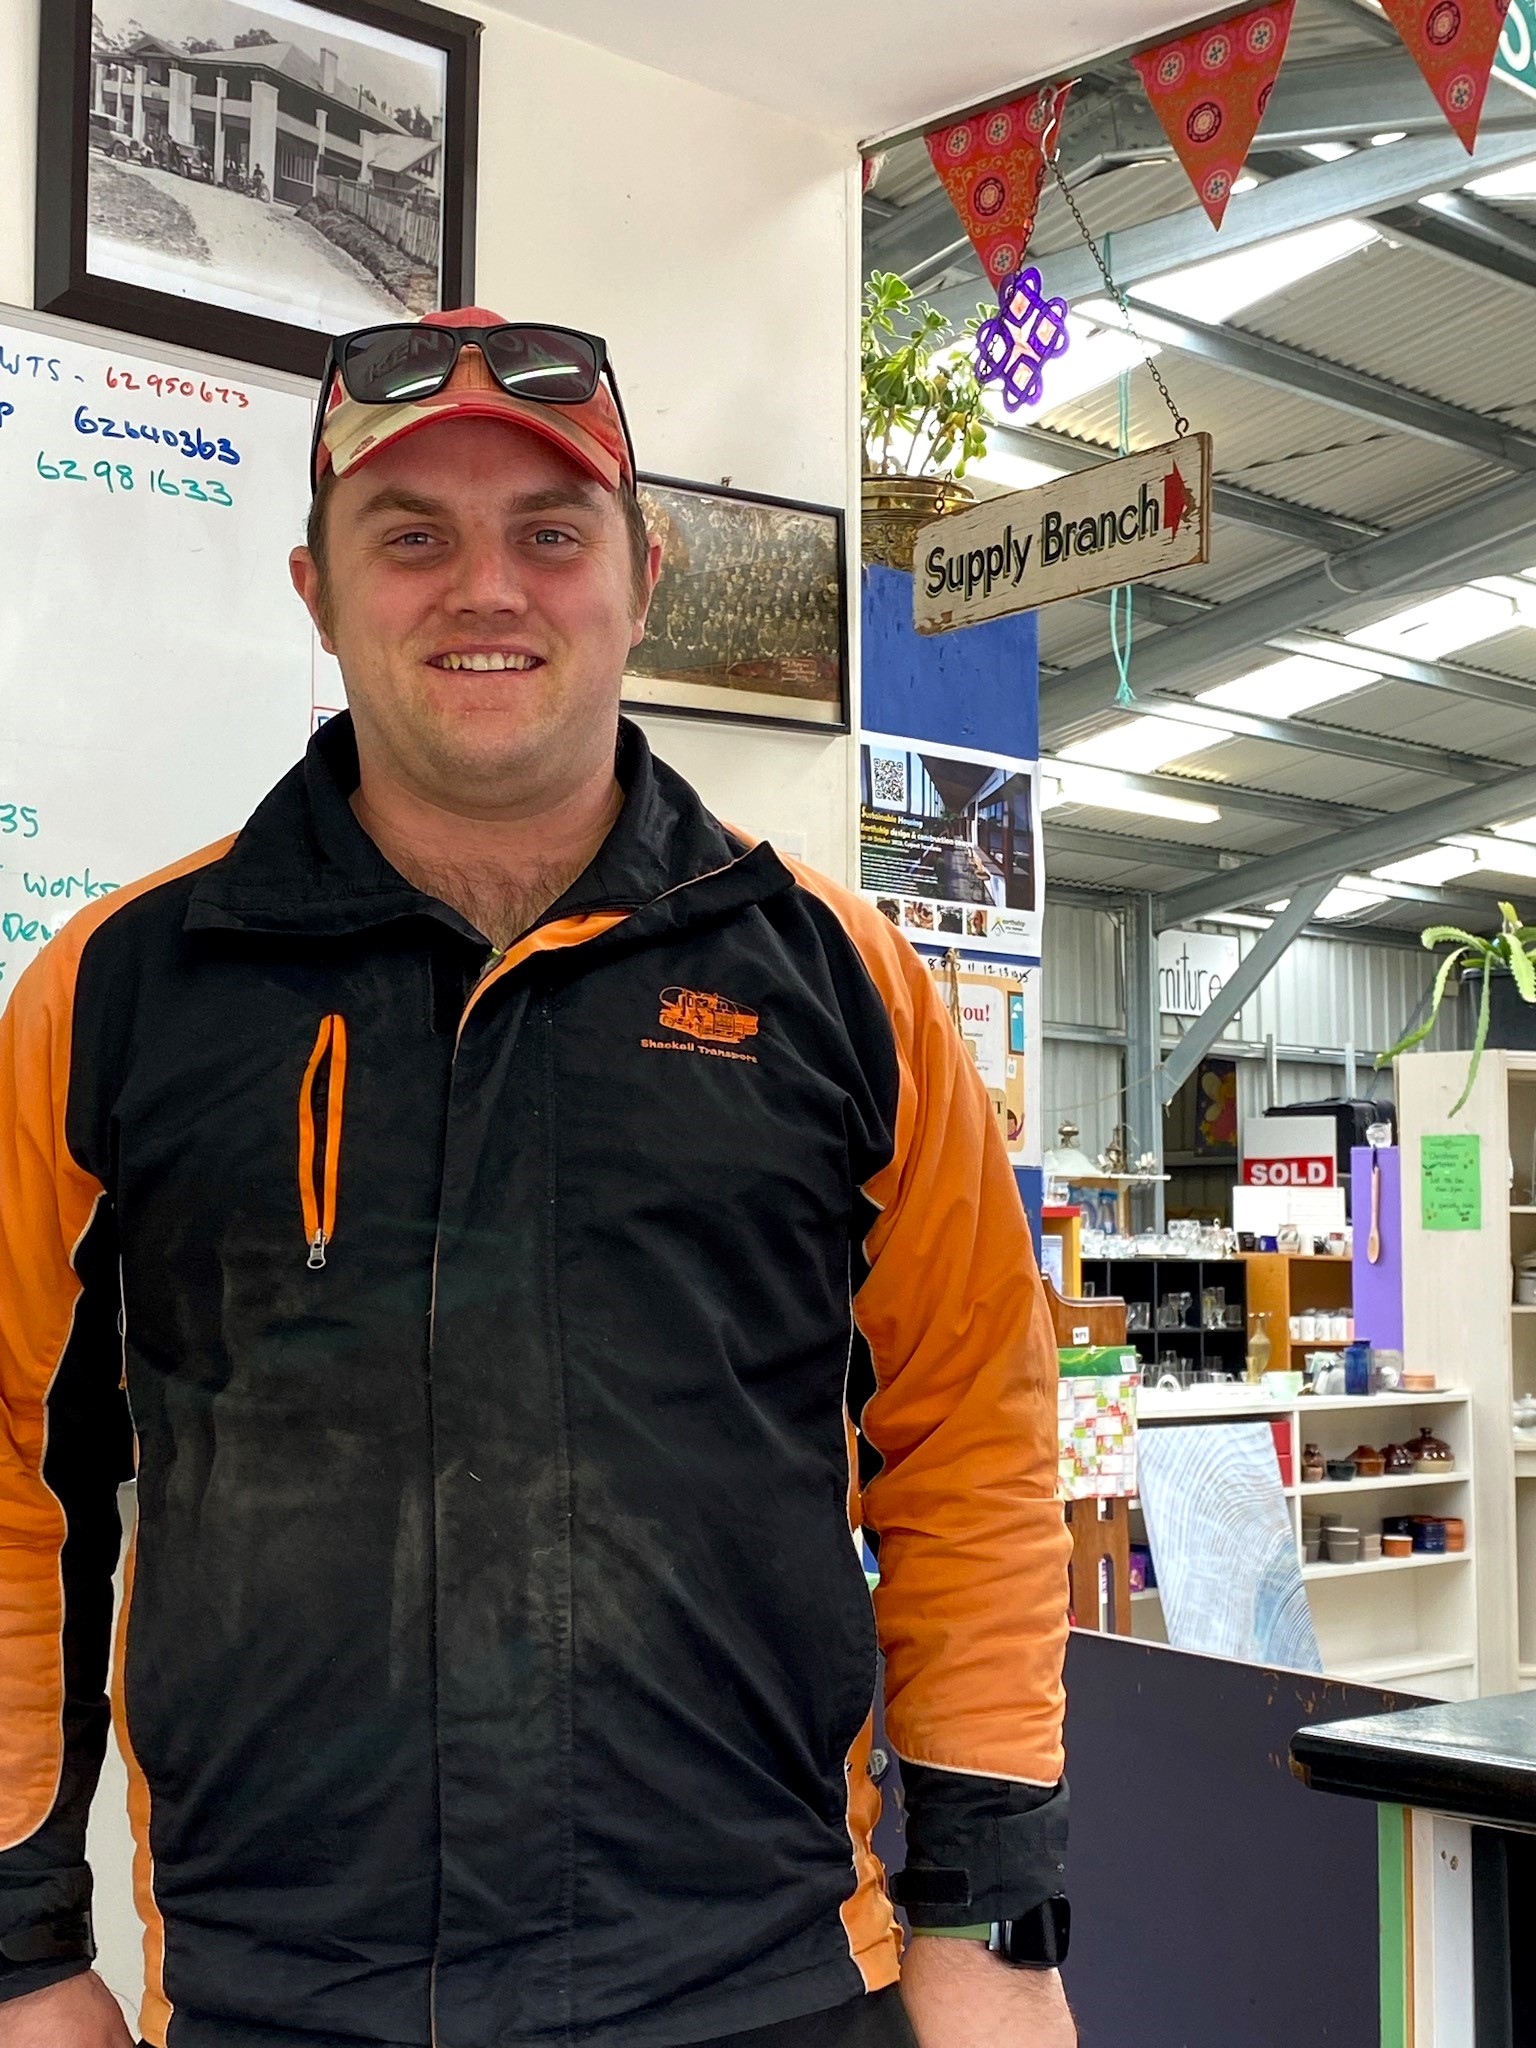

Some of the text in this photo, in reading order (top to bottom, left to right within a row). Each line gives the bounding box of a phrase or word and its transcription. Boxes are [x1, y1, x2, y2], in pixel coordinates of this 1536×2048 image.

[926, 483, 1159, 600] Supply Branch
[961, 1004, 990, 1022] ou!
[1250, 1162, 1327, 1185] SOLD
